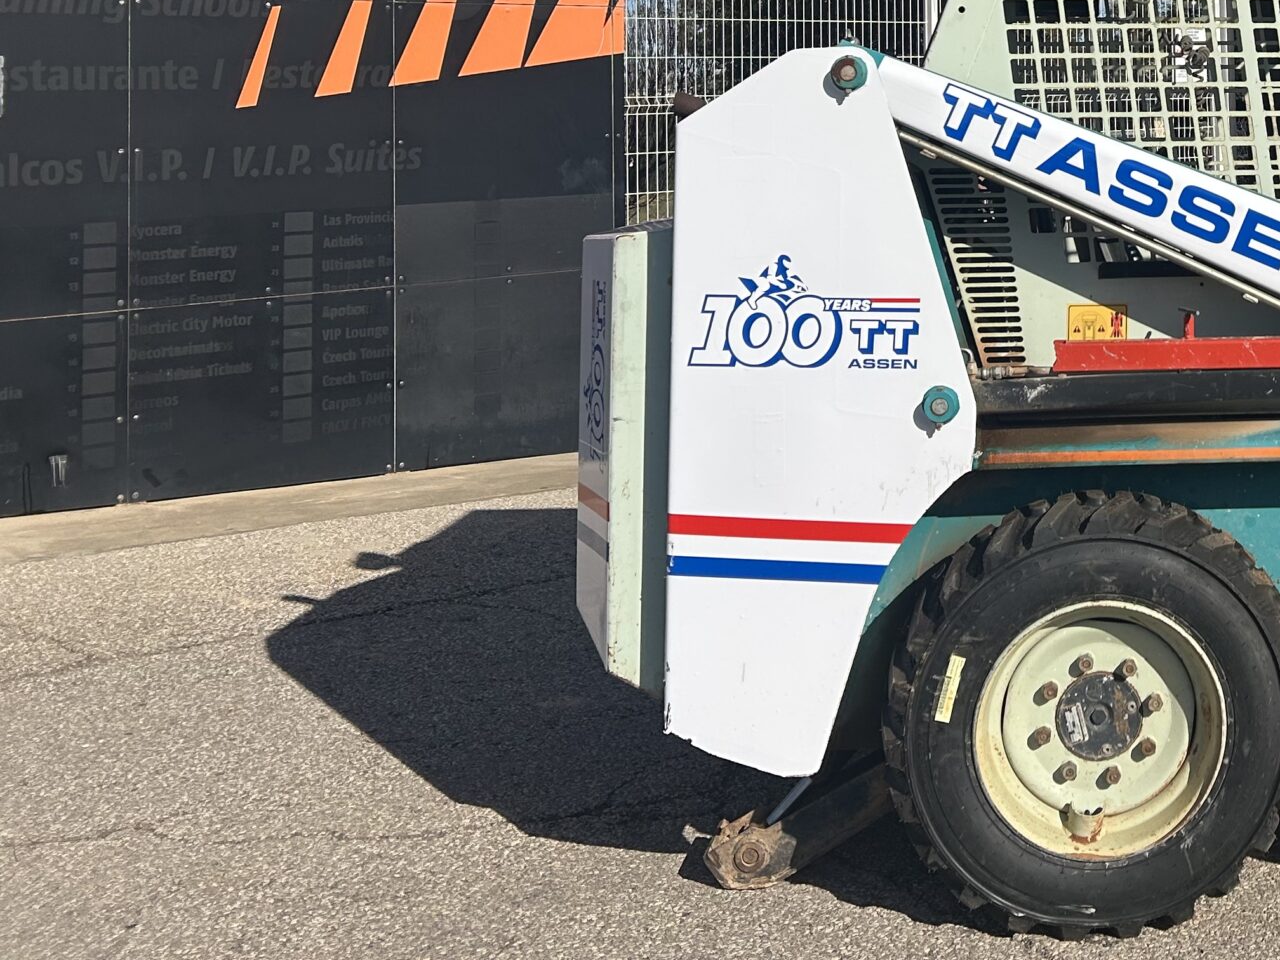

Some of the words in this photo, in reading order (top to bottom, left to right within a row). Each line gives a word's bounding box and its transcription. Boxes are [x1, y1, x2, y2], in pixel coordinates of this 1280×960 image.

[942, 82, 1042, 163] TT
[98, 148, 188, 184] V.I.P.
[234, 144, 312, 178] V.I.P.
[326, 142, 423, 175] Suites
[323, 214, 341, 227] Las
[190, 244, 238, 258] Energy
[189, 269, 237, 283] Energy
[822, 298, 872, 312] YEARS
[212, 314, 253, 329] Motor
[322, 328, 341, 341] VIP
[345, 325, 389, 339] Lounge
[687, 294, 844, 368] 100
[849, 319, 920, 355] TT
[848, 359, 918, 369] ASSEN
